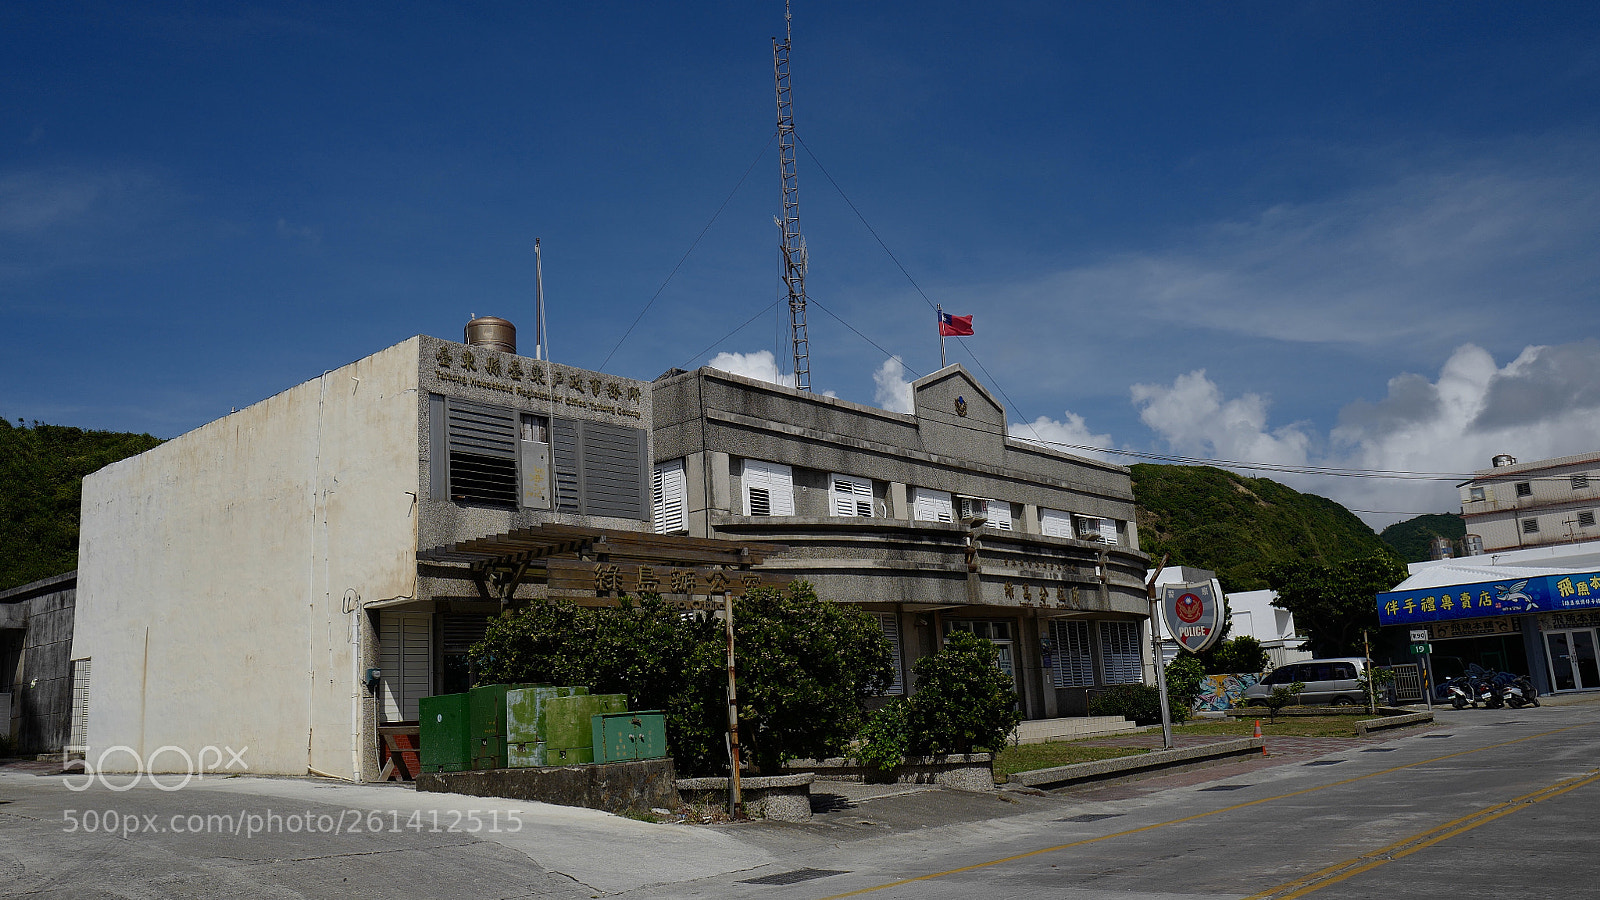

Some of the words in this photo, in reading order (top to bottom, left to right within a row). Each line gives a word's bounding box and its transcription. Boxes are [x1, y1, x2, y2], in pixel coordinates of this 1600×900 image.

[1384, 590, 1493, 616] 伴手禮專賣店
[1179, 626, 1206, 637] POLICE
[1415, 645, 1425, 653] 19
